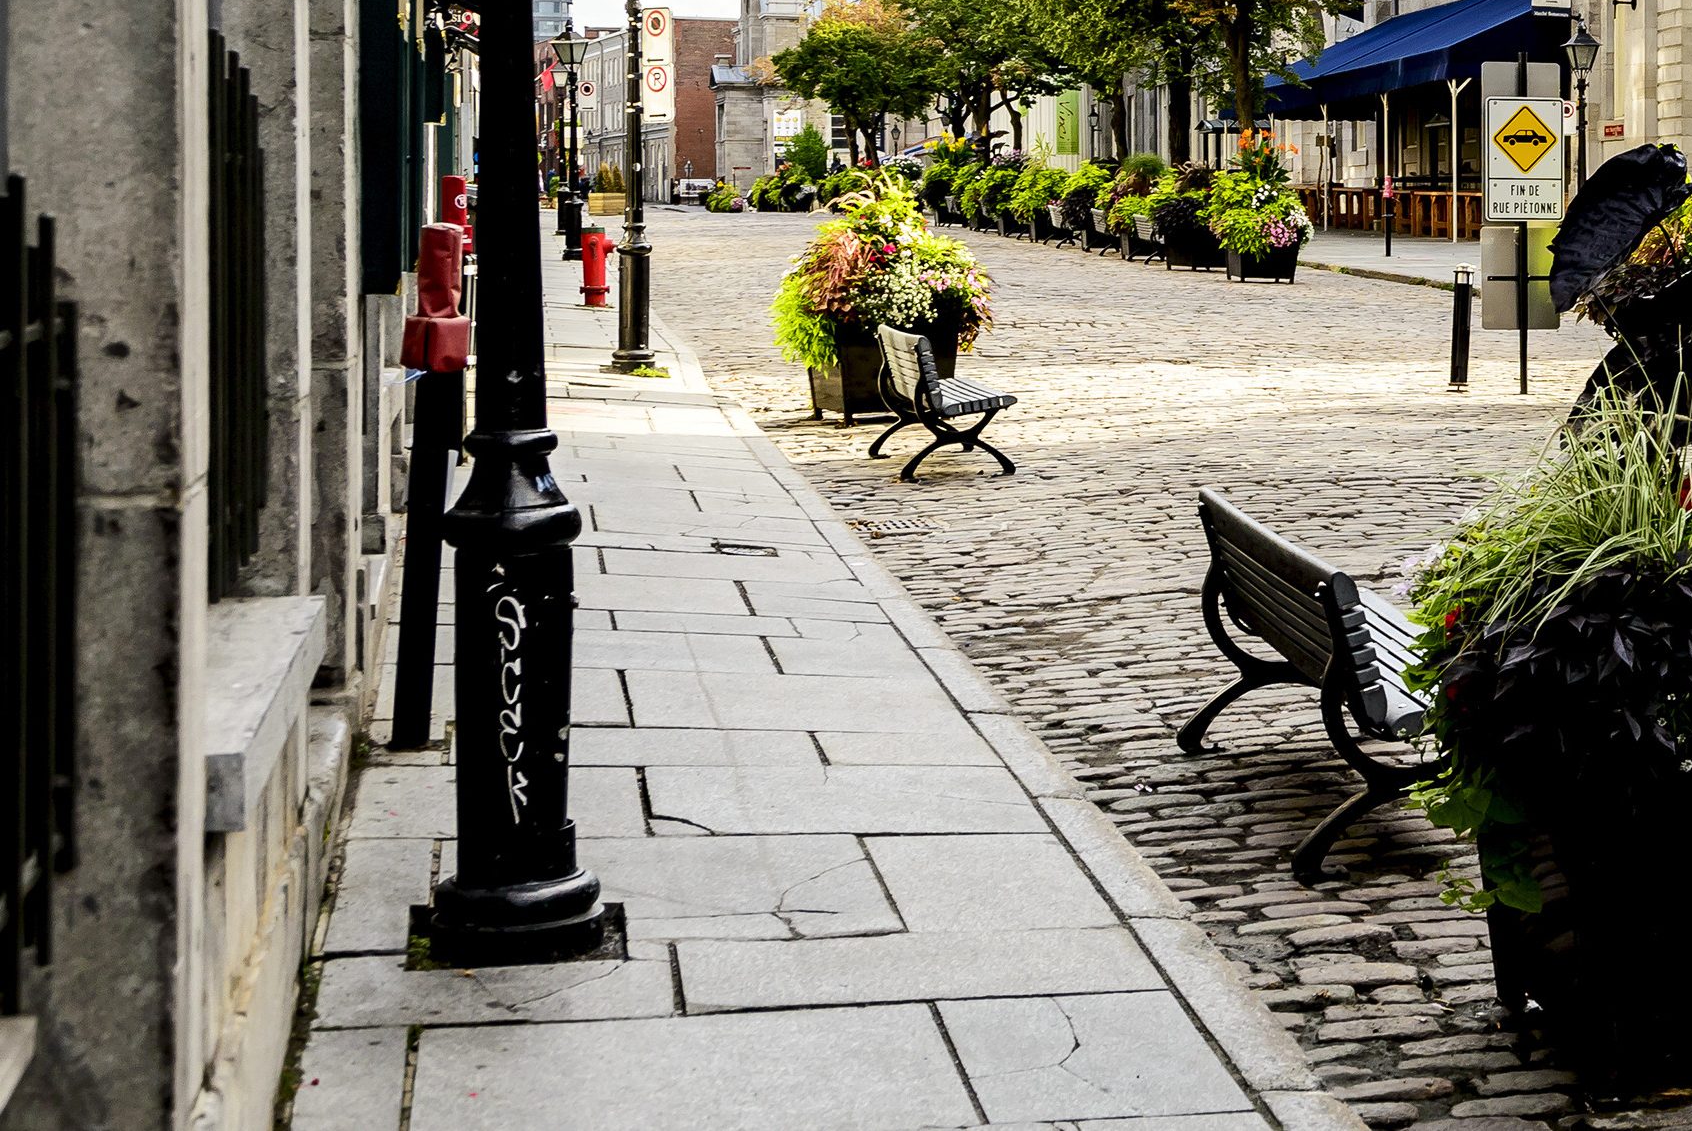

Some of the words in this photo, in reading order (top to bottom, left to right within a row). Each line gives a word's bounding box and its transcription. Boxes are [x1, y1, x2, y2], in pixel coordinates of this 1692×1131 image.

[1510, 185, 1525, 196] FIN
[1529, 185, 1540, 196] DE
[1493, 202, 1510, 213] RUE
